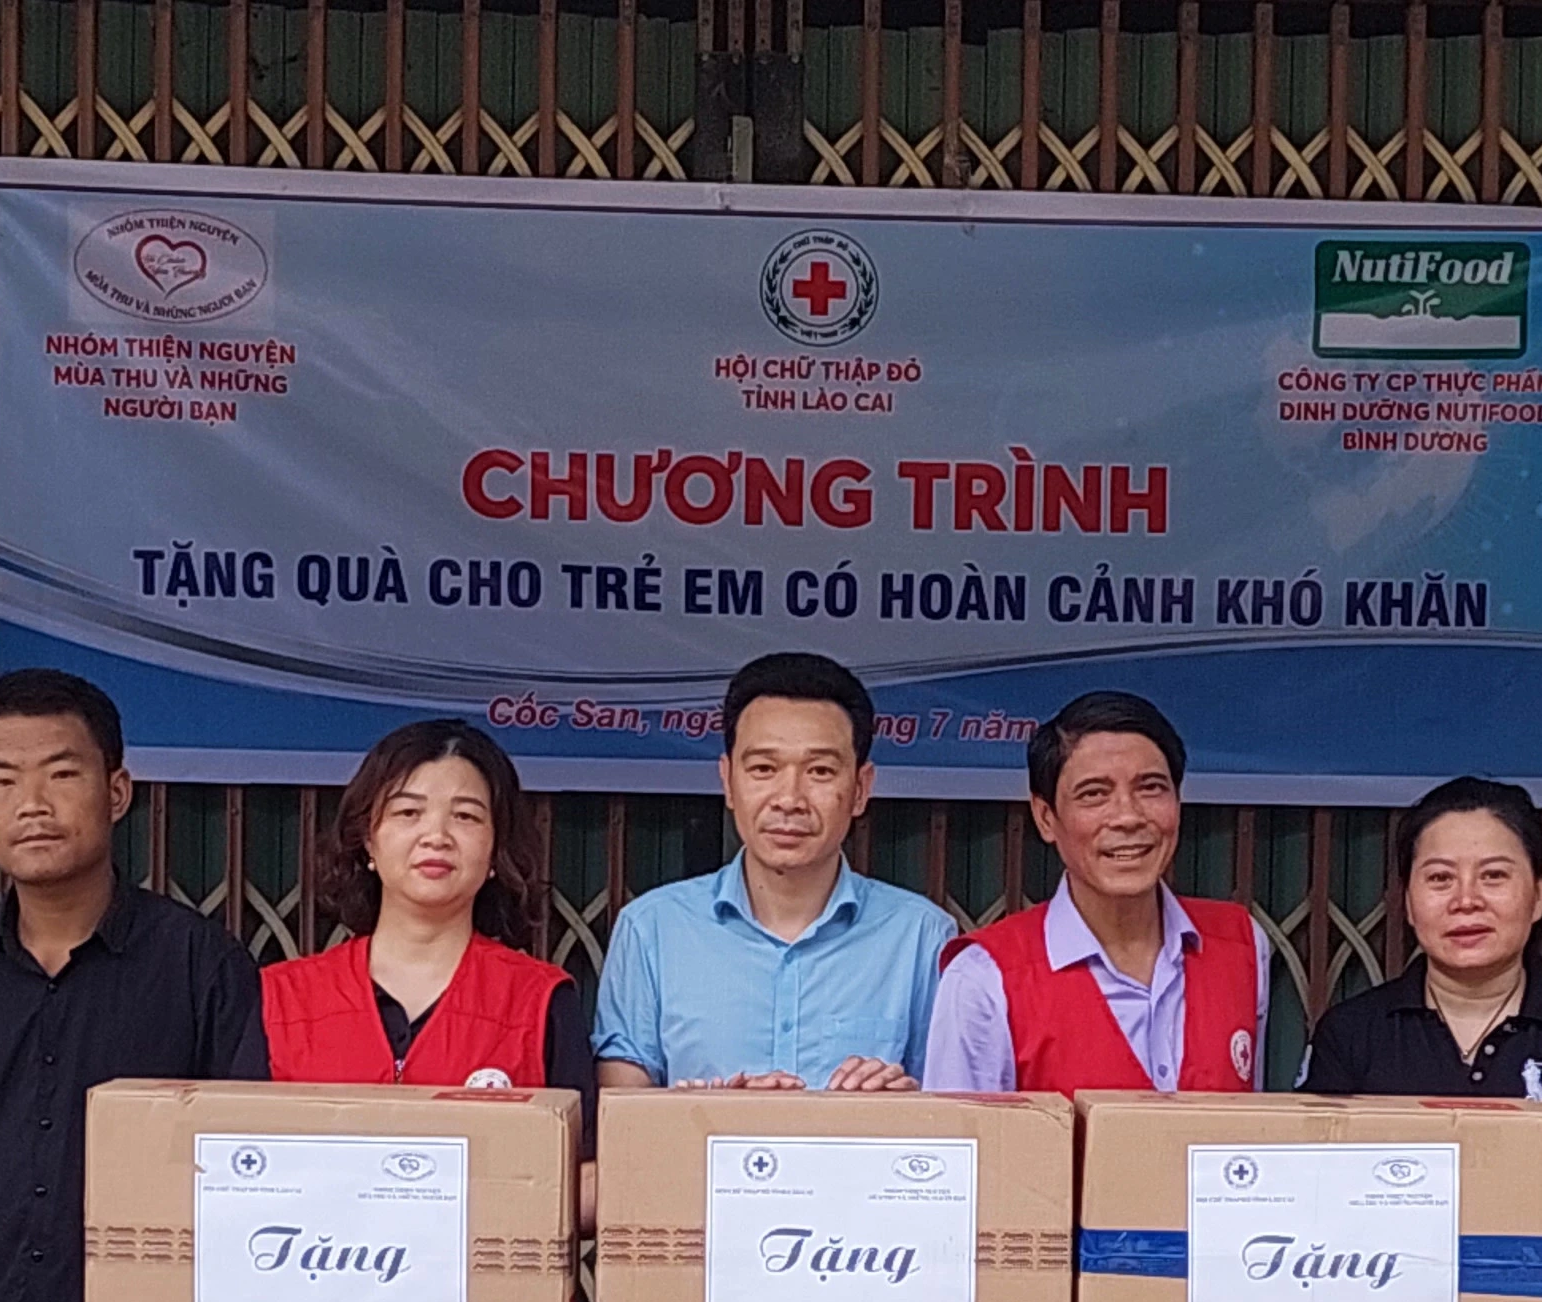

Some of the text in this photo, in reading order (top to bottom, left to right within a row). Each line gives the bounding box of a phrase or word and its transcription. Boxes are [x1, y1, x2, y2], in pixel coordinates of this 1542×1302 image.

[1331, 250, 1515, 285] NutiFood
[46, 333, 296, 369] NHÓM THIỆN NGUYỆN
[54, 362, 288, 394] MÙA THU VÀ NHỮNG
[715, 354, 921, 386] HỘI CHỮ THẬP ĐỎ
[1278, 367, 1346, 391] CÔNG
[1353, 373, 1379, 391] TY
[1386, 374, 1417, 391] CP
[1423, 371, 1487, 396] THỰC
[104, 396, 237, 426] NGƯỜI BẠN
[742, 384, 893, 412] TỈNH LÀO CAI
[1279, 402, 1335, 421] DINH
[1343, 398, 1430, 422] DƯỠNG
[1343, 428, 1488, 452] BÌNH DƯƠNG
[462, 445, 1168, 534] CHƯƠNG TRÌNH
[133, 540, 1487, 627] TẶNG QUÀ CHO TRẺ EM CÓ HOÀN CẢNH KHÓ KHĂN
[488, 692, 559, 728] Cốc
[661, 703, 725, 739] ngà
[930, 711, 947, 740] 7
[960, 712, 1039, 743] năm
[248, 1225, 411, 1283] Tặng
[759, 1226, 920, 1284] Tặng
[1242, 1234, 1405, 1289] Tặng
